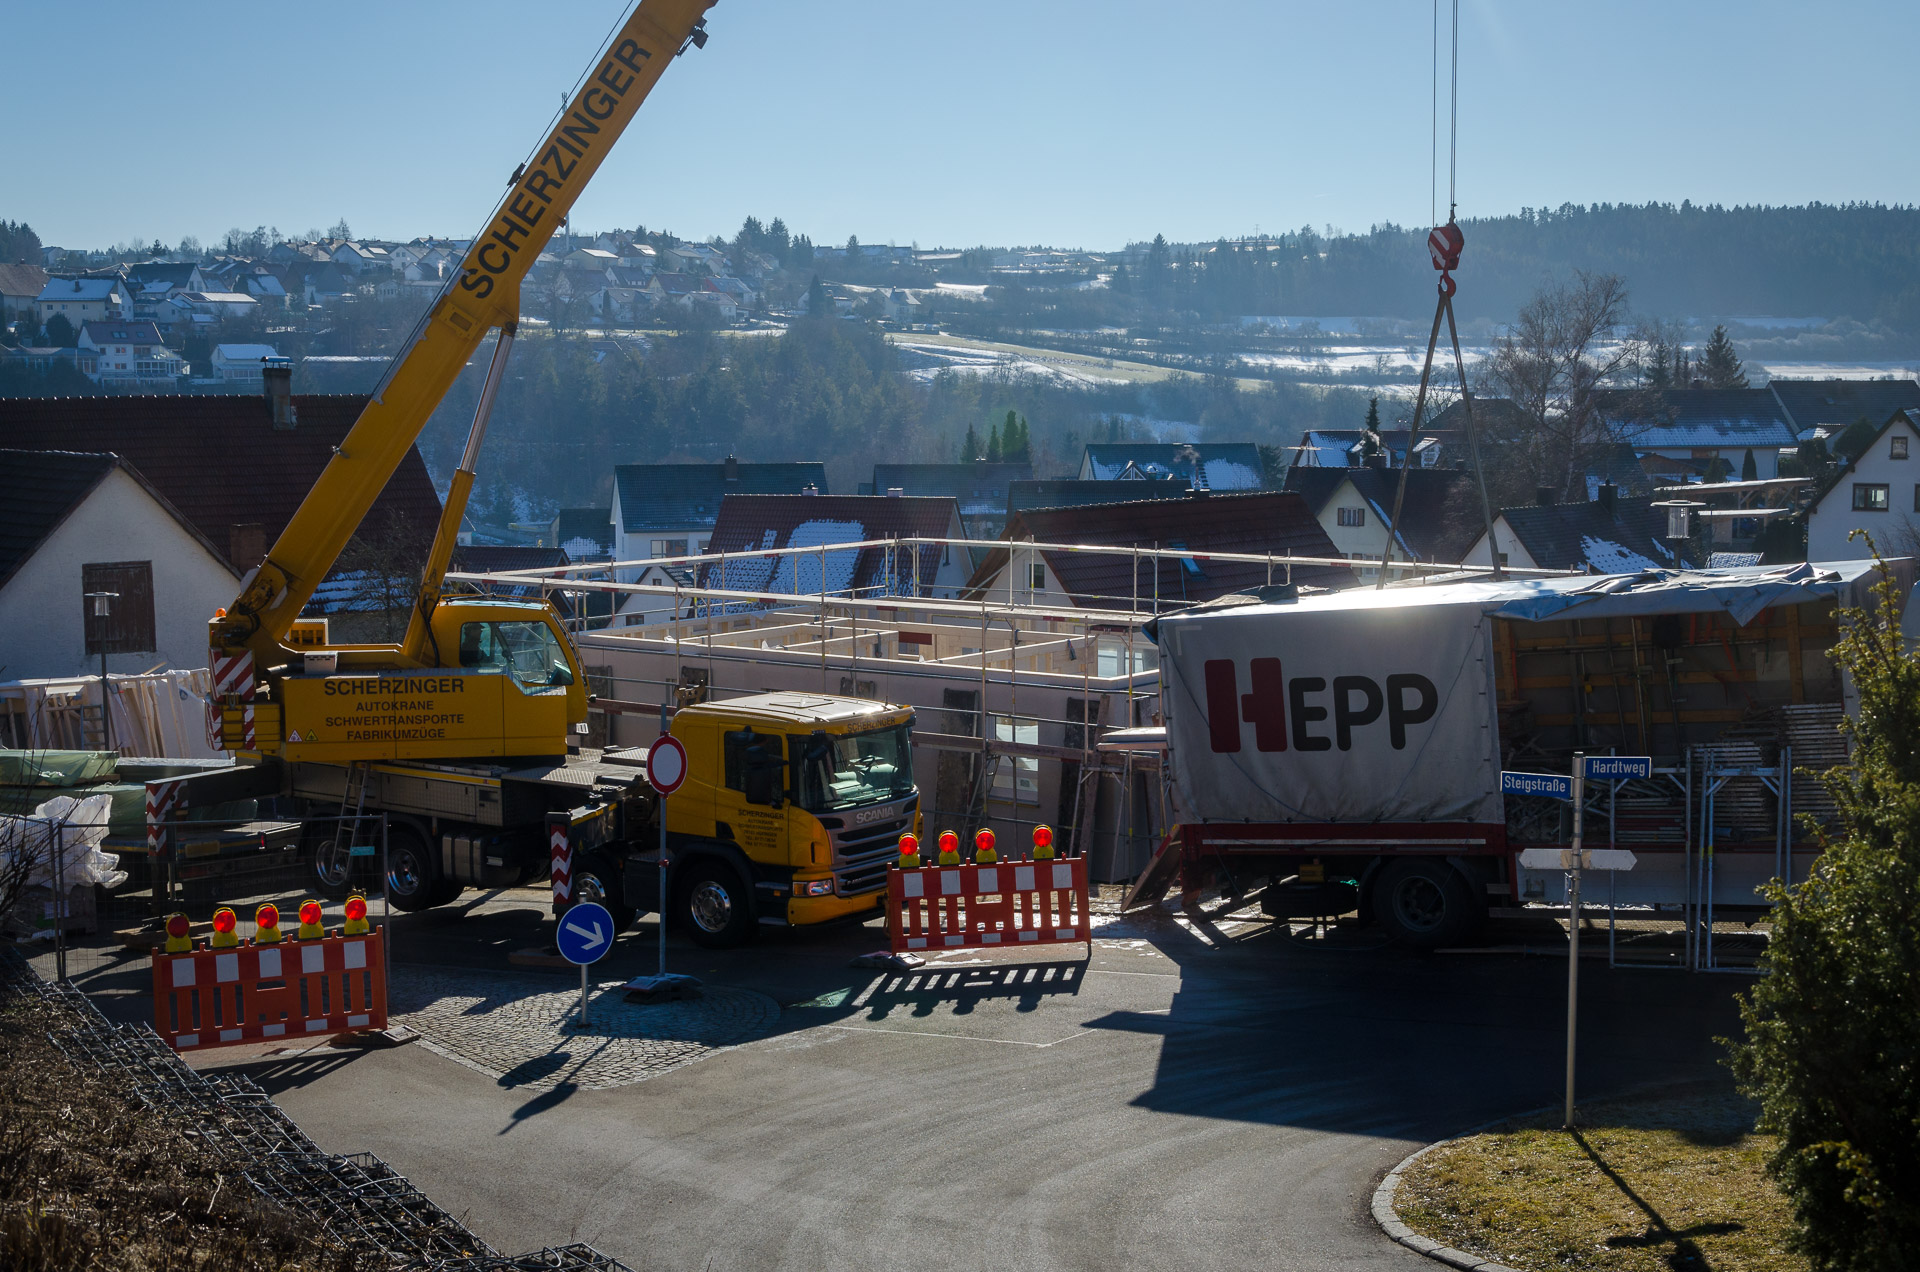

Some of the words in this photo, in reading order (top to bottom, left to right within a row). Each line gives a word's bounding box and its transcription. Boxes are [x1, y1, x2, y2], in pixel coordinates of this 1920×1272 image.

[461, 38, 652, 299] SCHERZINGER
[324, 678, 464, 696] SCHERZINGER
[356, 700, 434, 712] AUTOKRANE
[1204, 657, 1439, 754] HEPP
[325, 714, 464, 727] SCHWERTRANSPORTE
[847, 716, 895, 732] SCHERZINGER
[347, 727, 445, 740] FABRIKUMZÜGE
[1592, 760, 1646, 776] Hardtweg
[1504, 775, 1566, 793] Steigstraße
[738, 809, 784, 819] SCHERZINGER
[856, 806, 895, 824] SCANIA
